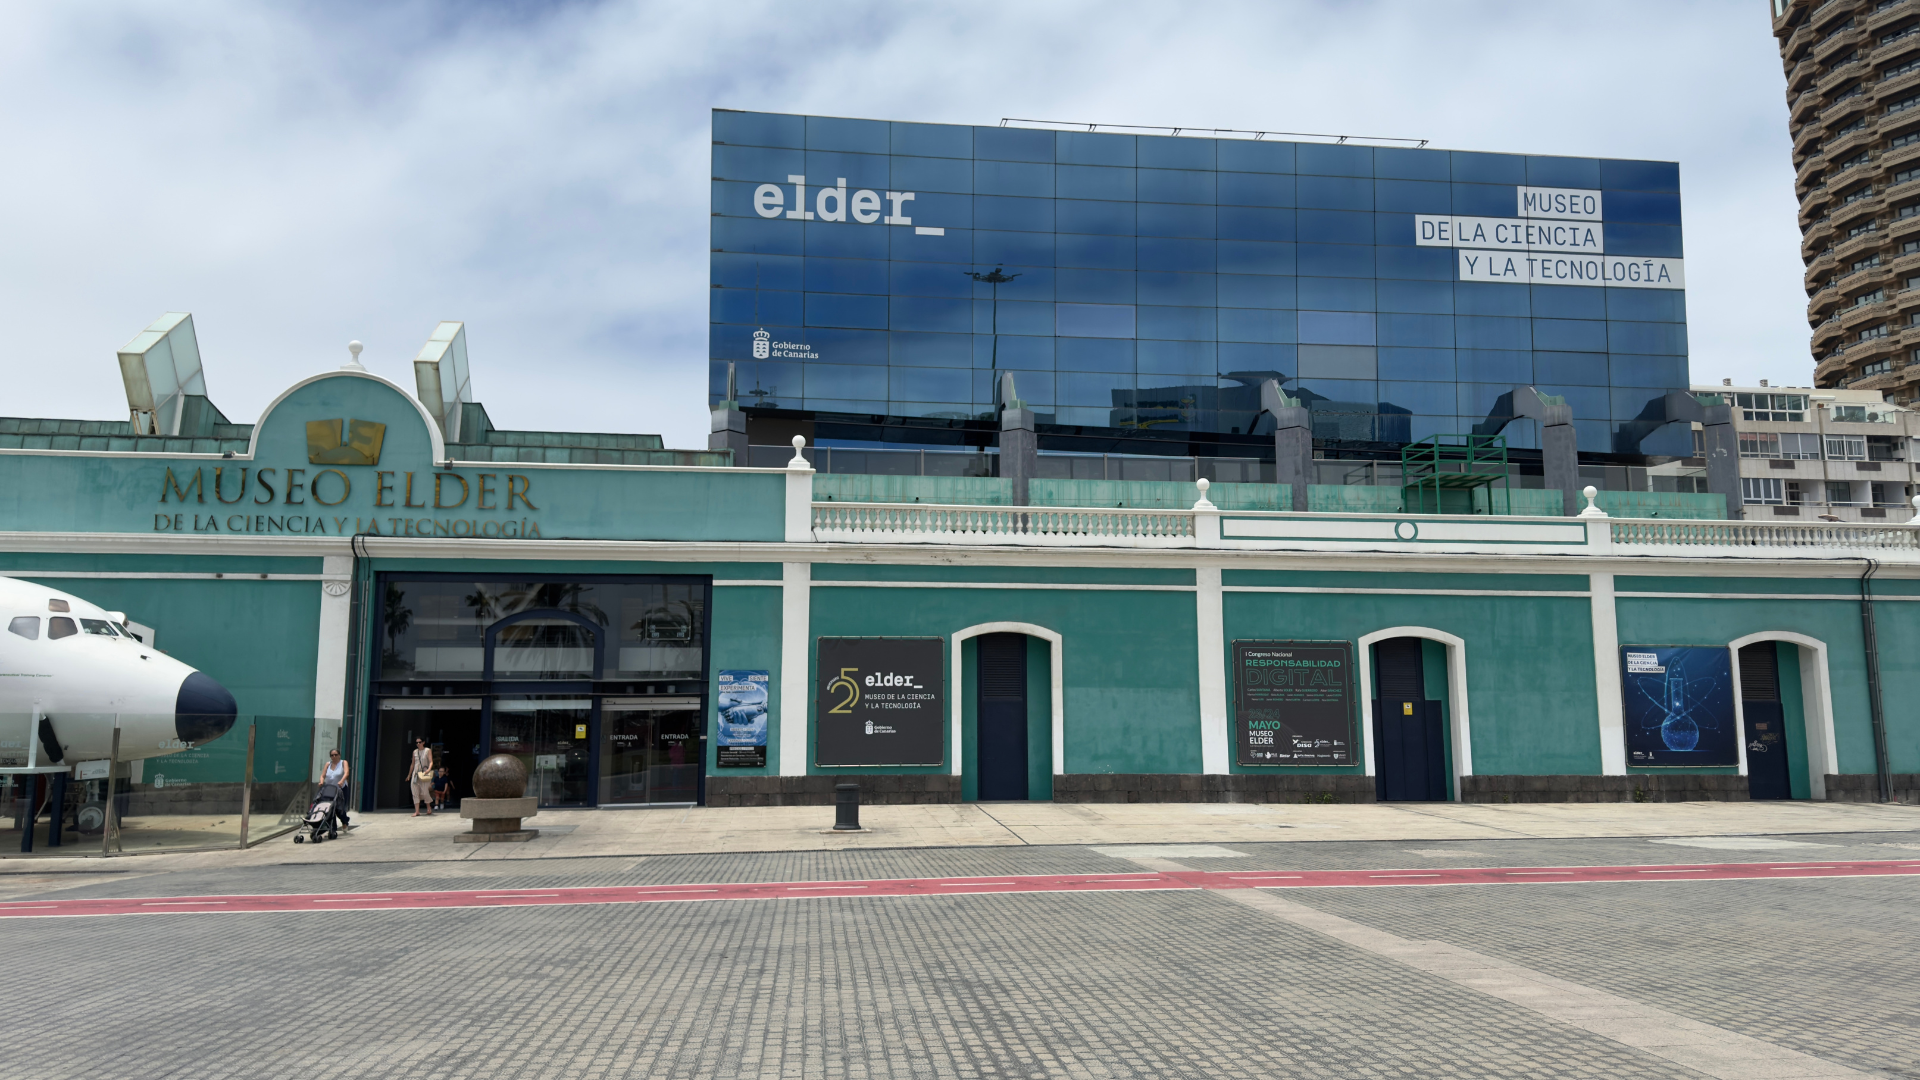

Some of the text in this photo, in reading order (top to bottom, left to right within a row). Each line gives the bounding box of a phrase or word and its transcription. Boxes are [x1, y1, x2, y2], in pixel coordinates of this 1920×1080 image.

[753, 174, 945, 237] elder_
[1522, 191, 1597, 216] MUSEO
[1421, 220, 1597, 248] DE LA CIENCIA
[1464, 256, 1672, 284] Y LA TECNOLOGÍA
[772, 341, 811, 351] Gobierno
[772, 349, 819, 360] de Canarias
[158, 467, 540, 512] MUSEO ELDER
[153, 513, 543, 539] DE LA CIENCIA Y LA TECNOLOGÍA
[1245, 659, 1341, 667] RESPONSABILIDAD
[1246, 668, 1343, 686] DIGITAL
[828, 667, 860, 714] 25
[1249, 721, 1281, 730] MAYO
[1249, 737, 1274, 745] ELDER
